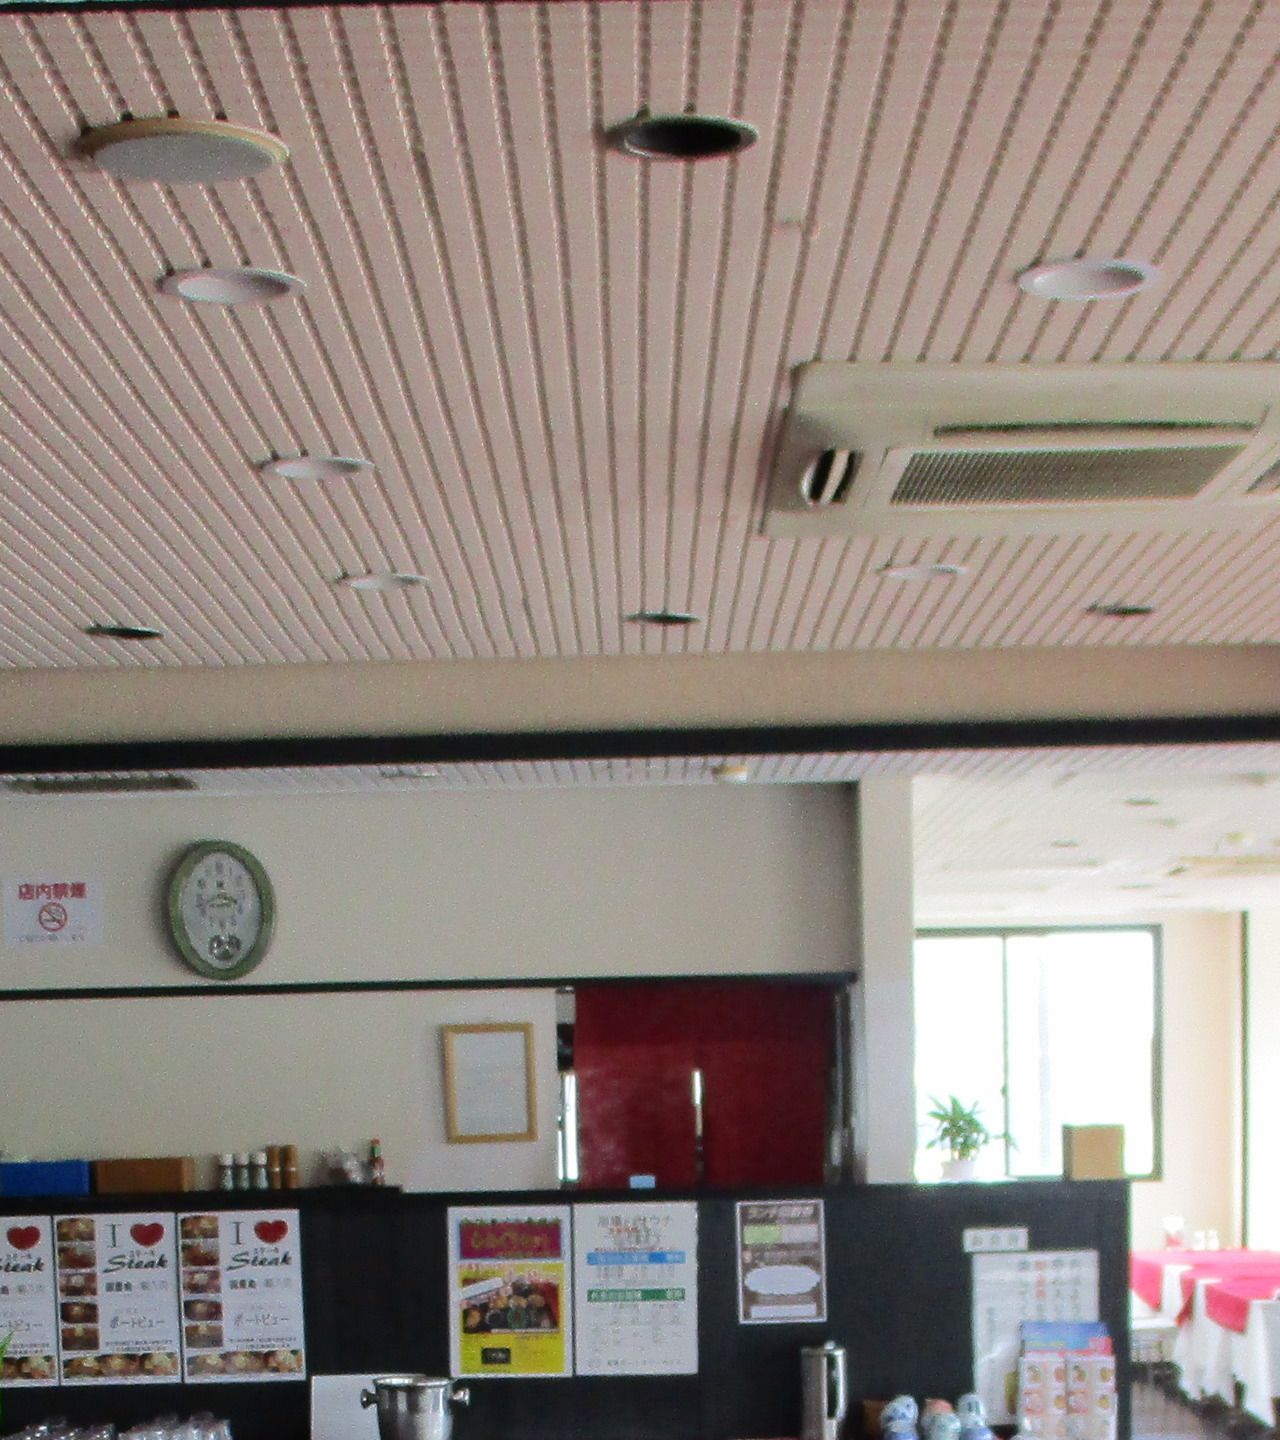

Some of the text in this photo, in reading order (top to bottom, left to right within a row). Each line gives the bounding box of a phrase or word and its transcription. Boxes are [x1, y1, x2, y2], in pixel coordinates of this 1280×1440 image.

[19, 883, 88, 900] 店内禁煙
[106, 1223, 122, 1248] I
[230, 1221, 245, 1245] I
[103, 1254, 168, 1273] Steak
[226, 1250, 291, 1271] Steak
